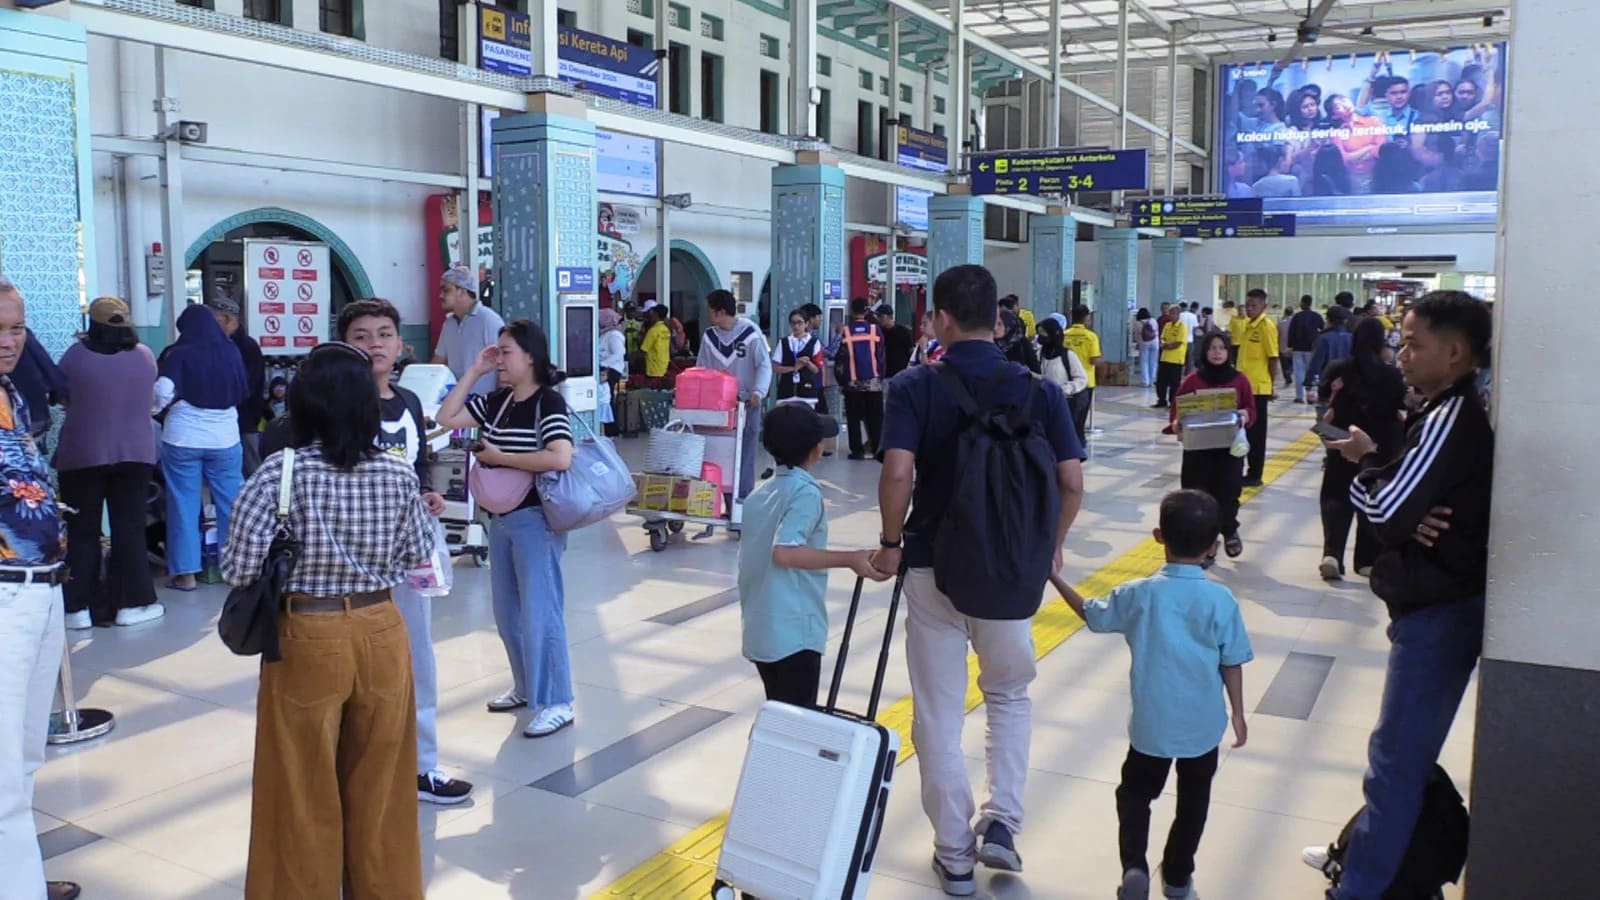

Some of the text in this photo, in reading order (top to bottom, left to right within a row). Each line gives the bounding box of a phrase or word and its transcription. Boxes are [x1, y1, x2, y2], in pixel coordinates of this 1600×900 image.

[511, 16, 568, 46] Infsi
[571, 33, 608, 55] Kereta
[610, 44, 628, 63] Api
[484, 44, 531, 61] PASARSENE
[1236, 119, 1491, 143] Kalau hidup sering tertekuk, lemesin aja.
[1011, 154, 1116, 167] Keberangkatan KA Antarkota
[1018, 178, 1028, 191] 2
[1039, 176, 1060, 184] Peron
[735, 342, 747, 358] S
